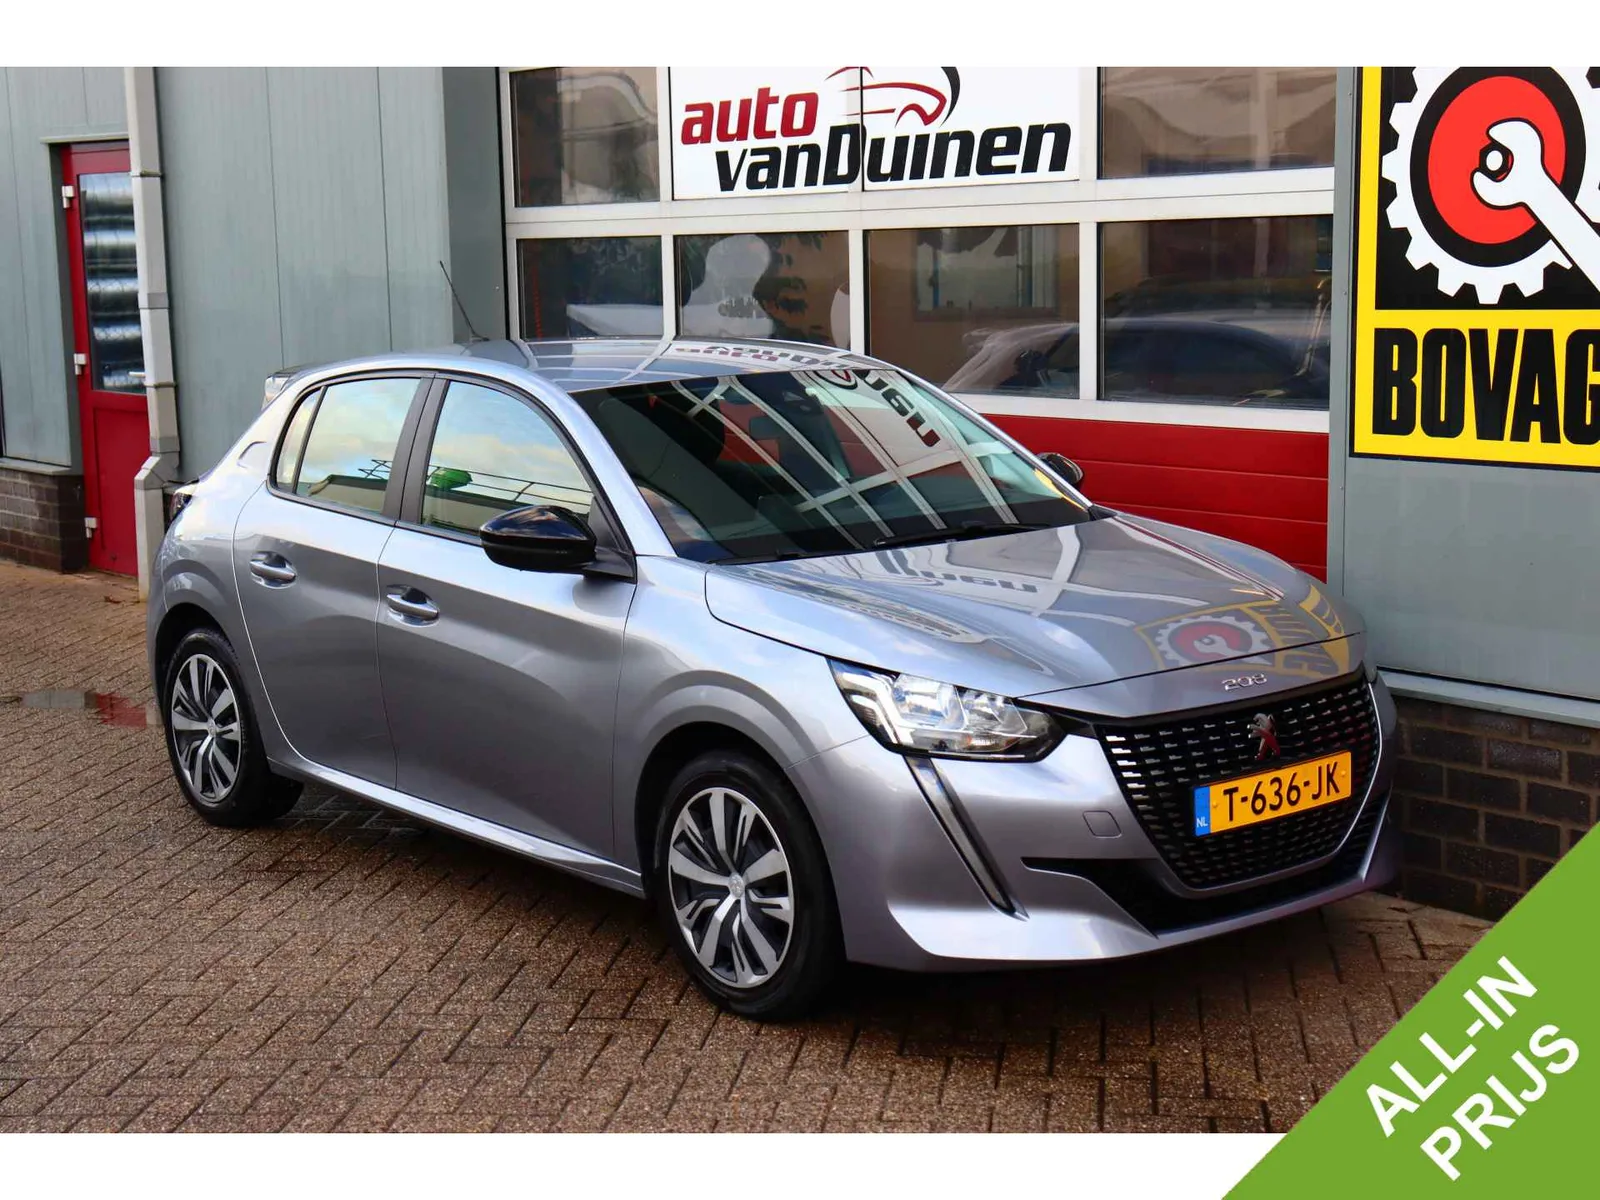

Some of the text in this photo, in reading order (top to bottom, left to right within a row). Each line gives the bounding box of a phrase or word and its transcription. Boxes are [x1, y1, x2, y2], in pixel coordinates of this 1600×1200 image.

[681, 87, 819, 144] auto
[715, 122, 1071, 191] vanDuinen
[1372, 328, 1600, 445] BOVAG
[1221, 673, 1267, 691] 208
[1223, 761, 1340, 822] T-636-JK
[1196, 816, 1208, 827] NL
